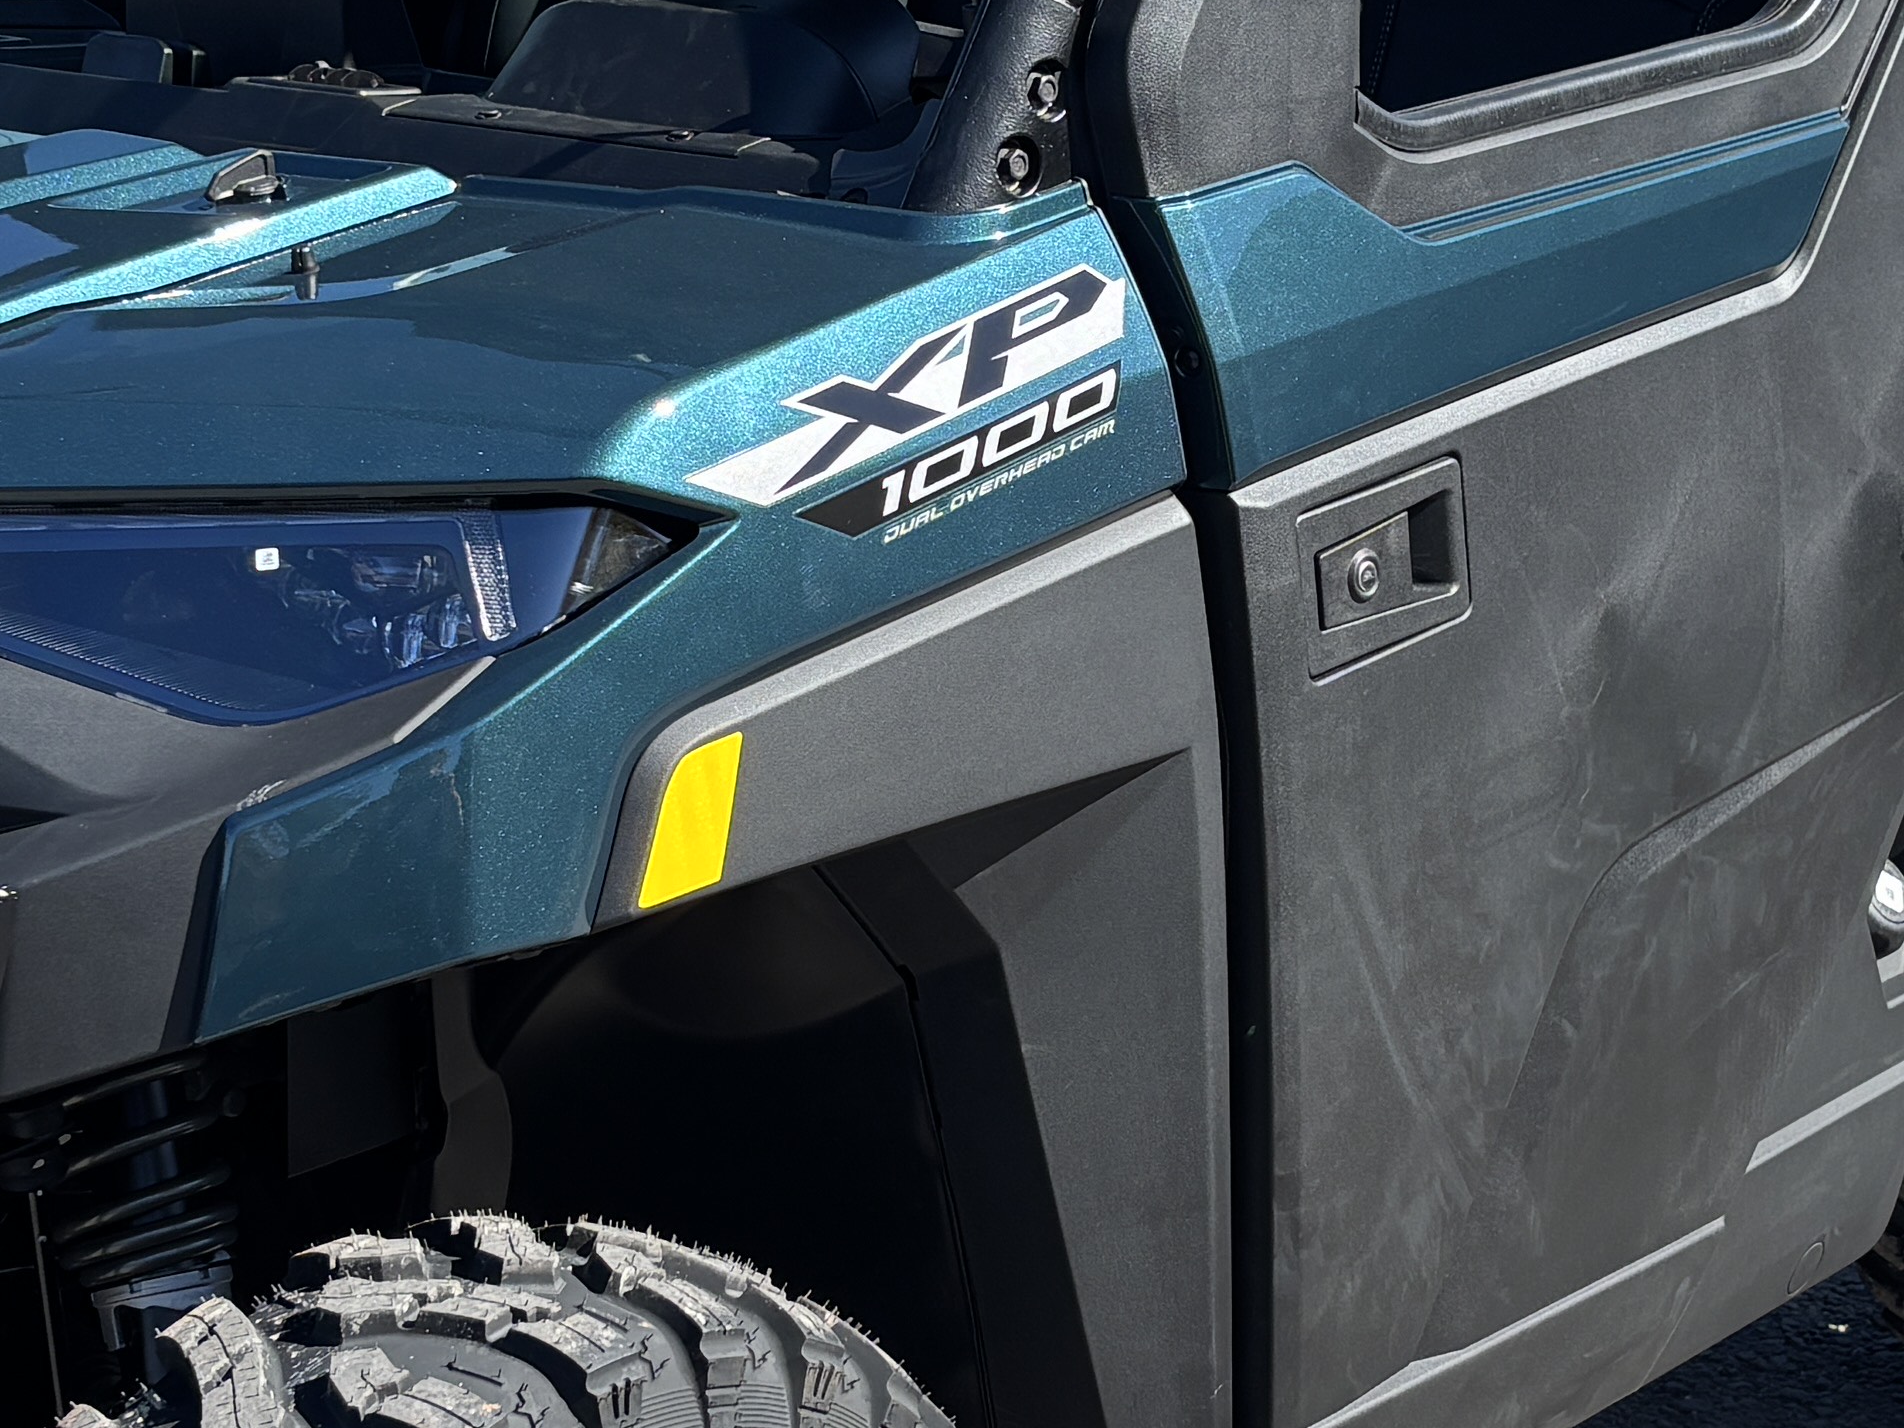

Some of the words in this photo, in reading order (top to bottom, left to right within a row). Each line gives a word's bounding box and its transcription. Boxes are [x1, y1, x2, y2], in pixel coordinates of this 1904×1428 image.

[775, 269, 1107, 495] XP
[882, 368, 1117, 517] 1000
[883, 504, 944, 544] DUAL
[950, 445, 1065, 512] OVERHEAD
[1070, 420, 1116, 451] CAM
